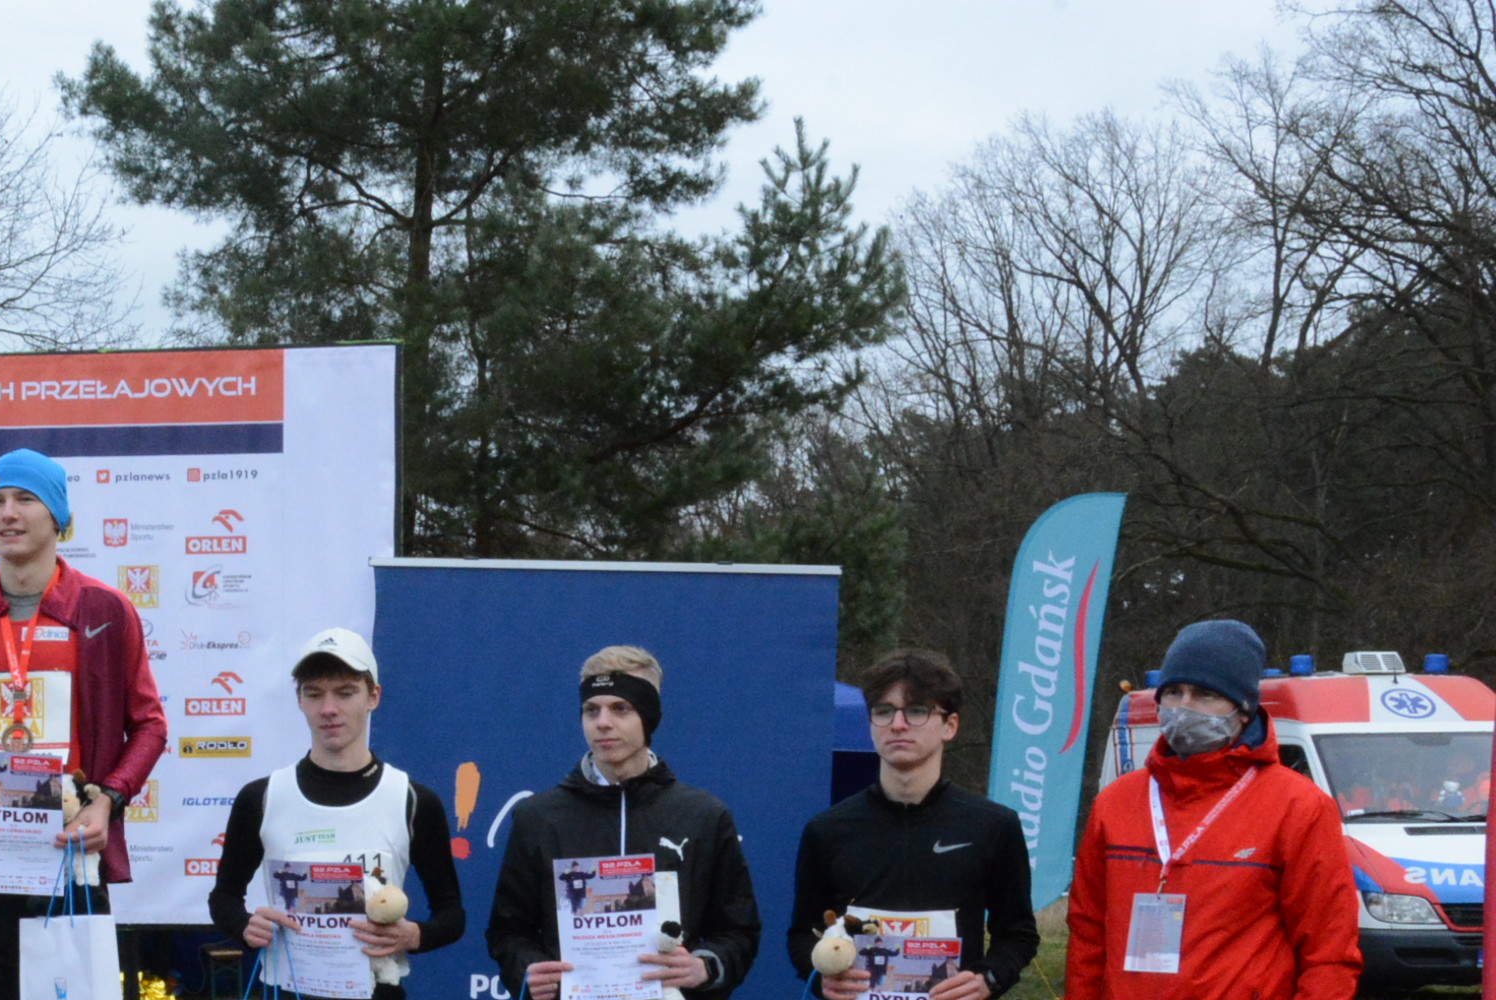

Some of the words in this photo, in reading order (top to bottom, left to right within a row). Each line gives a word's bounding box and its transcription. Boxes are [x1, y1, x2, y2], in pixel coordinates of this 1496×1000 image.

[21, 375, 256, 400] PRZEŁAJOWYCH
[115, 470, 171, 484] pzlanews
[203, 468, 259, 482] pzla1919
[130, 523, 174, 531] Ministerstwo
[130, 533, 154, 542] Sportu
[187, 538, 244, 552] ORLEN
[1011, 550, 1077, 736] Gdańsk
[187, 700, 243, 714] ORLEN
[130, 854, 153, 862] Sportu
[188, 861, 220, 873] ORL
[573, 913, 643, 930] DYPLOM
